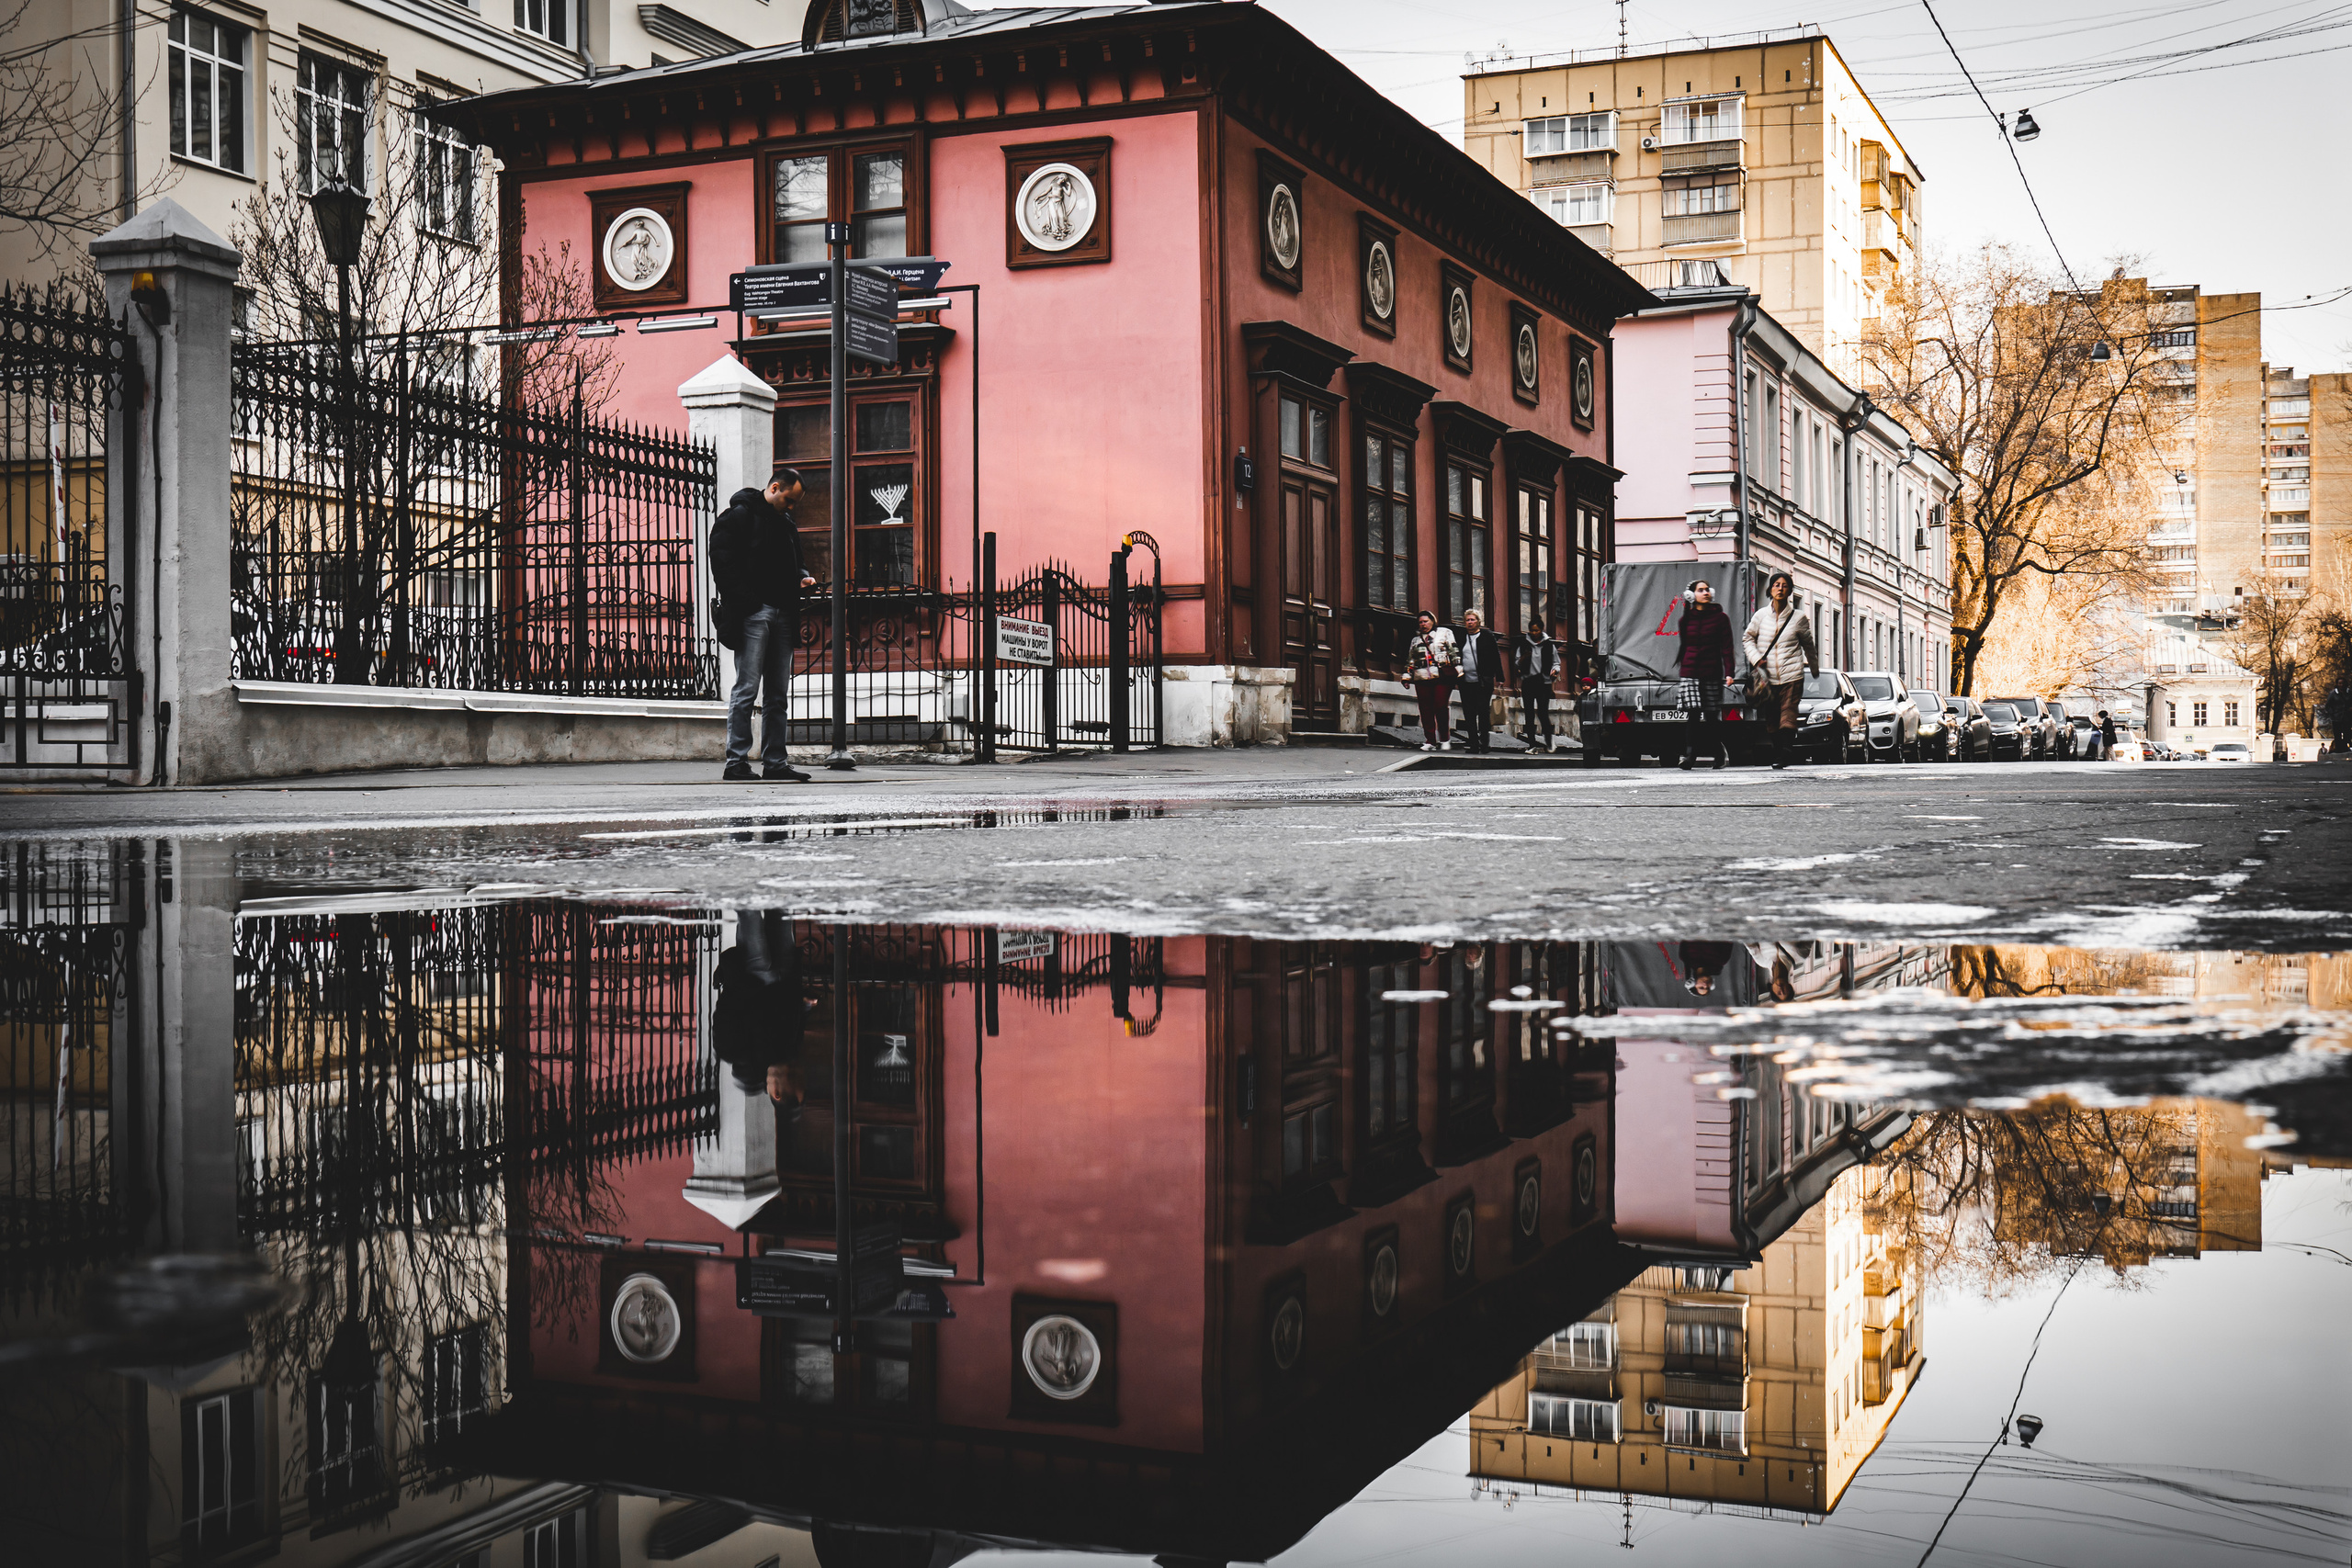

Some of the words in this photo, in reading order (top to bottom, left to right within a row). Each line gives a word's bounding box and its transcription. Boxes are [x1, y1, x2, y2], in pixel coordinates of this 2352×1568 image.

[744, 282, 760, 290] Театра
[1244, 464, 1251, 478] 12
[1001, 620, 1029, 634] ВНИМАНИЕ
[1031, 626, 1049, 638] ВЫЕЗД
[1001, 633, 1026, 647] МАШИНЫ
[1027, 638, 1031, 647] У
[1031, 638, 1048, 650] ВОРОТ
[1009, 647, 1016, 658] НЕ
